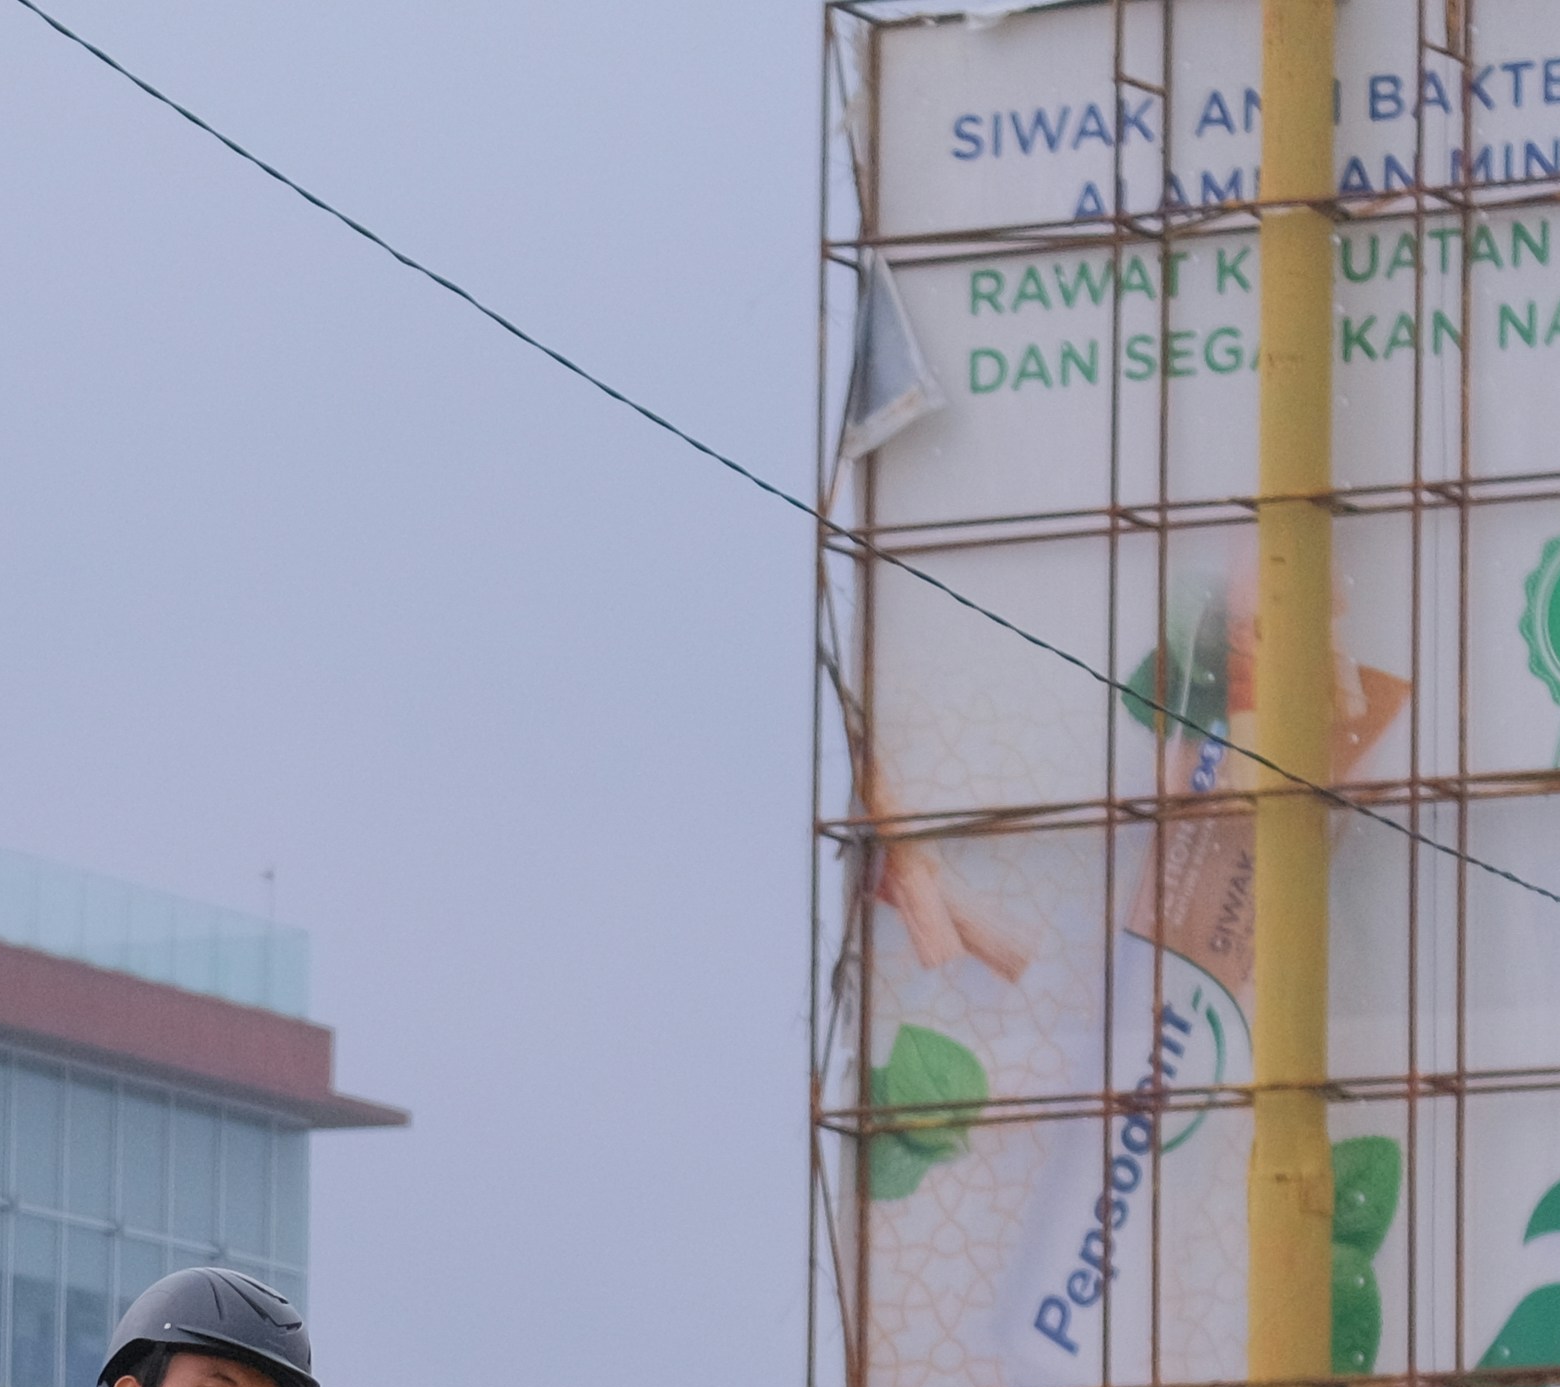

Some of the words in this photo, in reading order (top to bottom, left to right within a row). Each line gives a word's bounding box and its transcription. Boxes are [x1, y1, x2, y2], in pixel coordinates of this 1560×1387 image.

[953, 98, 1154, 161] SIWAK
[970, 252, 1189, 315] RAWAT
[1216, 219, 1550, 294] KUATAN
[969, 339, 1100, 394] DAN
[1124, 309, 1466, 381] SEGKAN
